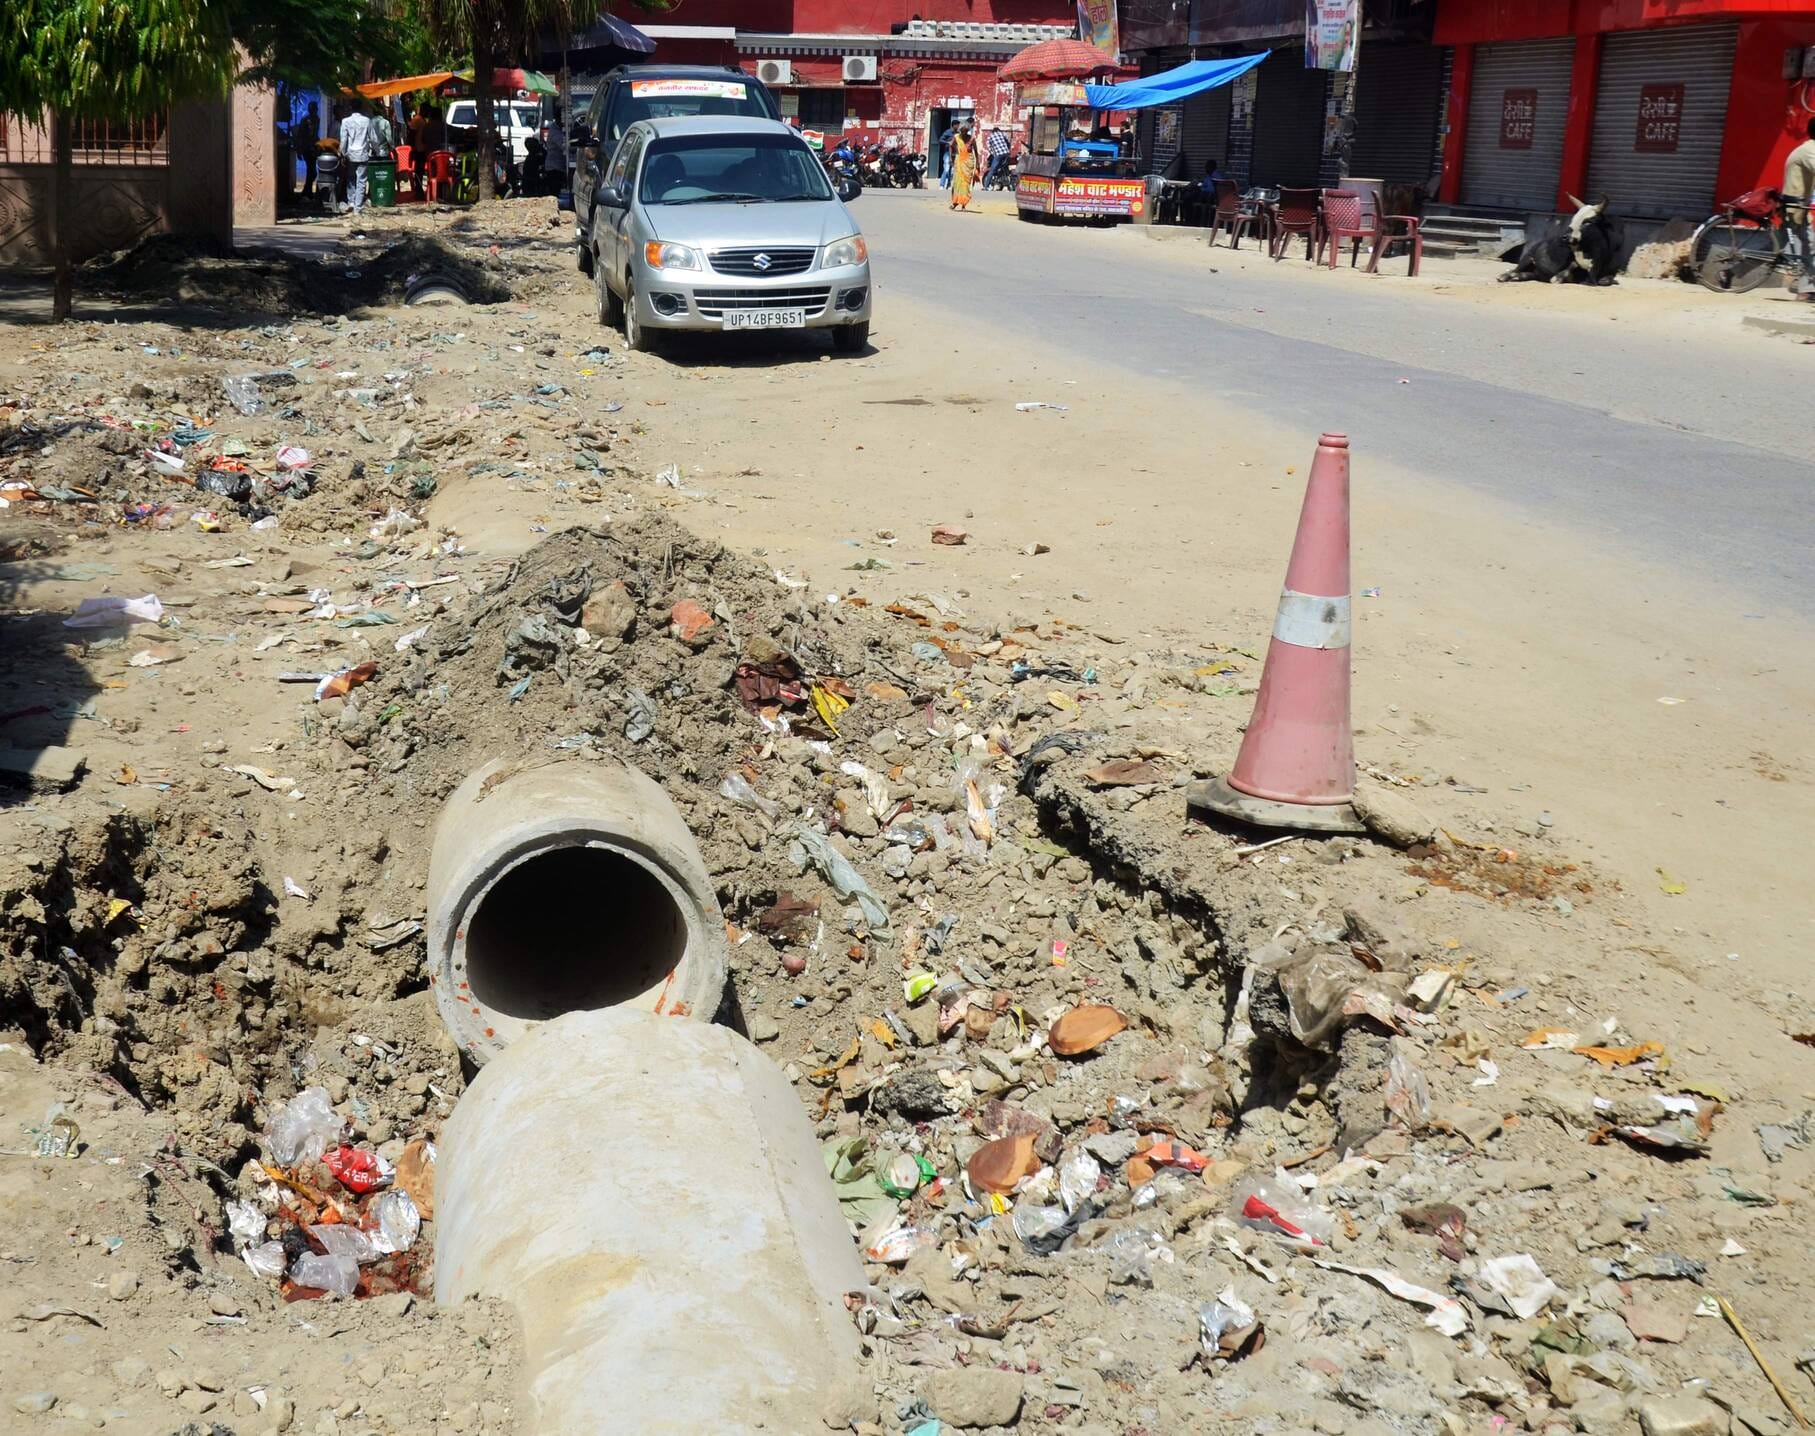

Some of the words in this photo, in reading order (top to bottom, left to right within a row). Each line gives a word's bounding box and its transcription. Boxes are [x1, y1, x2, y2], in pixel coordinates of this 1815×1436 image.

[1506, 122, 1532, 140] CAFE
[1645, 122, 1677, 141] CAFE
[1058, 180, 1085, 196] महेश
[1087, 183, 1107, 197] चाट
[1109, 185, 1143, 198] भण्डार
[730, 311, 802, 327] UP14BF9651
